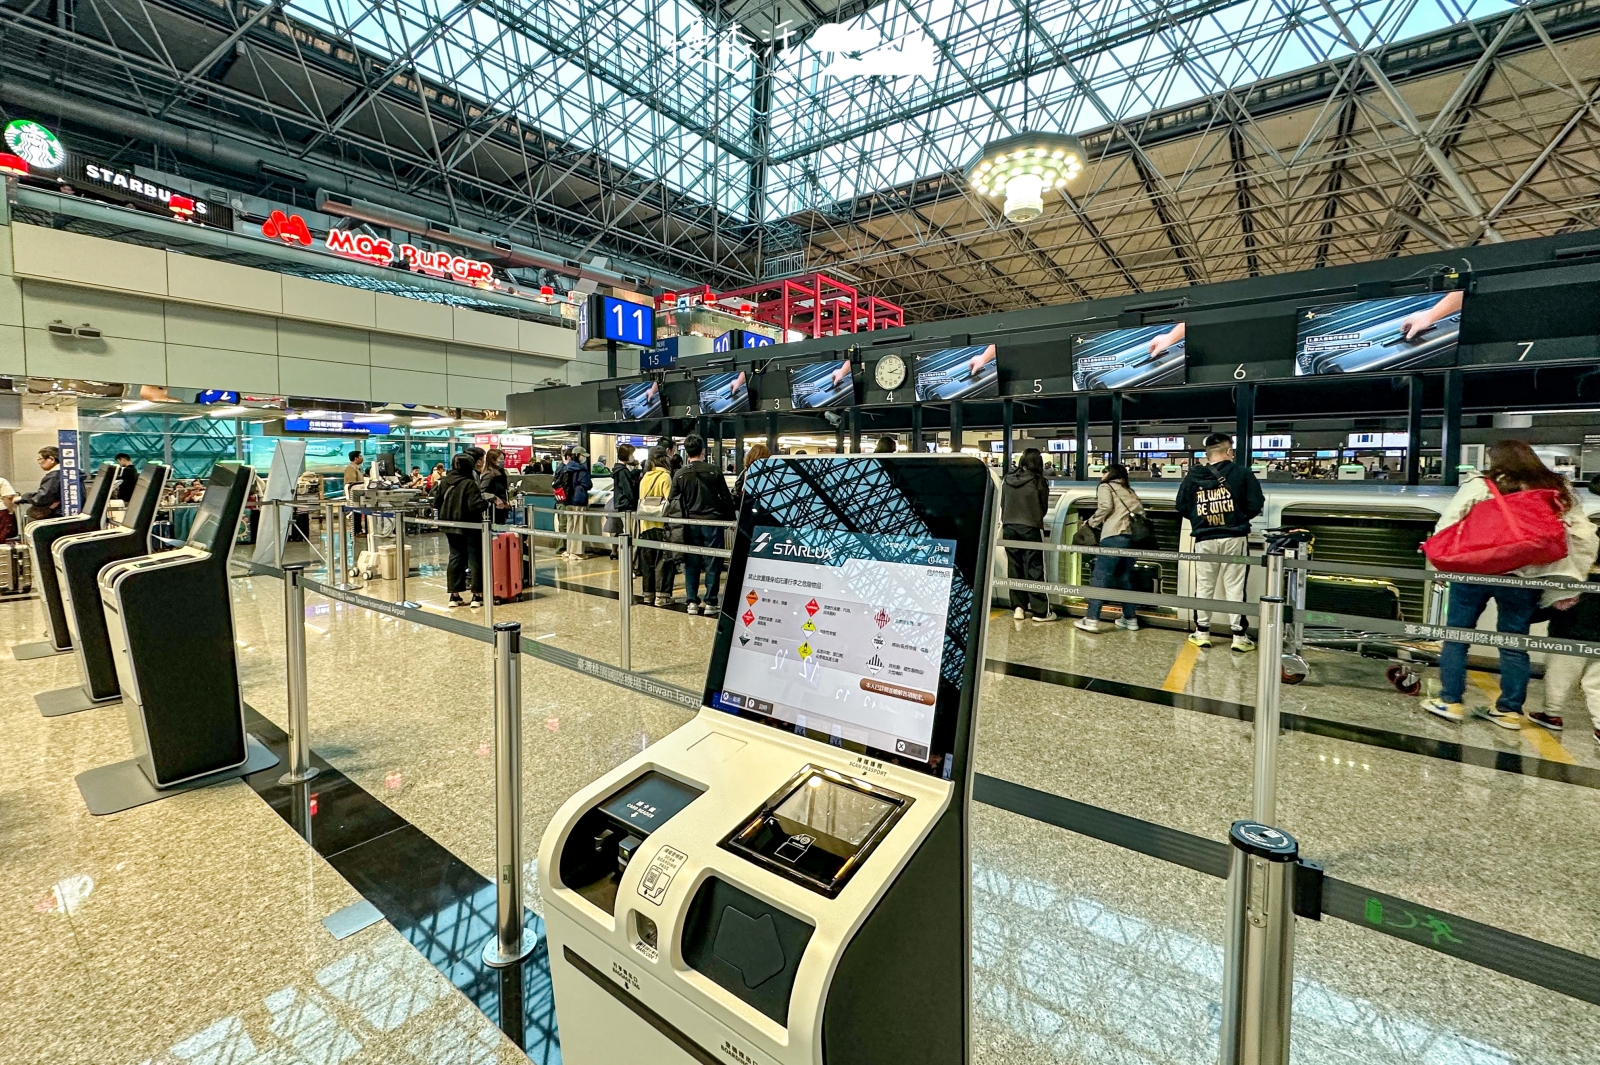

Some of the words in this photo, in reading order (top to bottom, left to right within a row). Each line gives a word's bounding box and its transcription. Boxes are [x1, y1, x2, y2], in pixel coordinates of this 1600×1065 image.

[86, 164, 207, 214] STARBUS
[326, 228, 394, 262] MOS
[612, 304, 643, 341] 11
[1517, 342, 1534, 361] 7
[648, 354, 660, 366] 1-5
[1234, 363, 1246, 380] 6
[1033, 379, 1043, 393] 5
[886, 391, 894, 403] 4
[686, 406, 692, 416] 2
[774, 399, 780, 410] 3
[613, 412, 617, 420] 1
[1196, 487, 1232, 504] ALWAYS
[1197, 502, 1208, 516] BE
[1207, 513, 1226, 526] YOU
[773, 543, 834, 559] STARLUX
[1119, 549, 1142, 557] Taoyuan
[1142, 550, 1179, 559] International
[1179, 552, 1201, 560] Airport
[1434, 573, 1465, 582] Airport
[1466, 574, 1523, 587] International
[1009, 579, 1052, 591] International
[1052, 584, 1079, 595] Airport
[1525, 579, 1566, 590] Taoyuan
[1567, 583, 1600, 593] Taiwan
[1403, 624, 1520, 649] 臺灣桃園國際機場
[1522, 637, 1572, 652] Taiwan
[643, 679, 673, 699] Taiwan
[848, 761, 862, 769] SCAN
[861, 764, 888, 777] PASSPORT
[626, 803, 639, 811] CARD
[664, 854, 676, 863] SCAN
[659, 862, 670, 871] PASS
